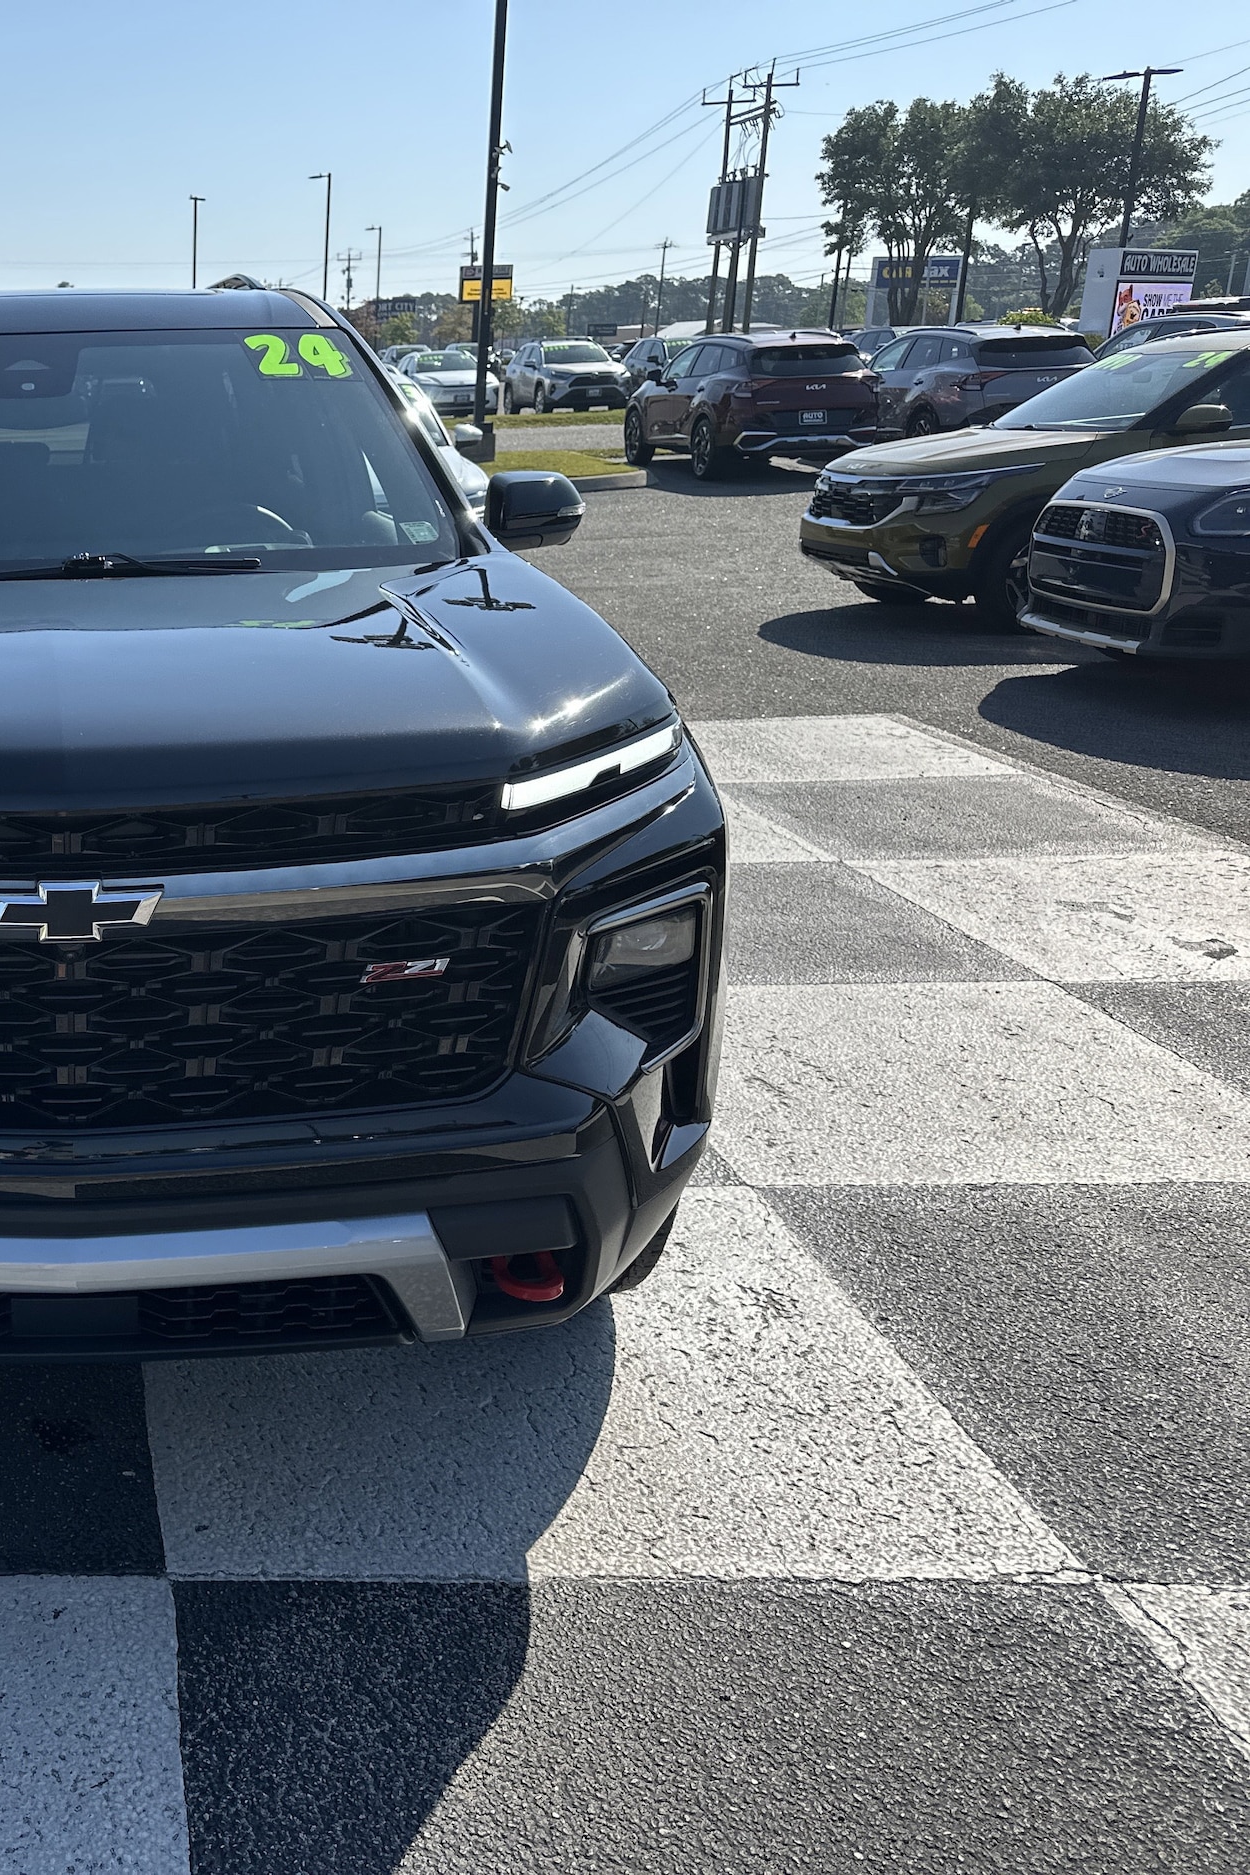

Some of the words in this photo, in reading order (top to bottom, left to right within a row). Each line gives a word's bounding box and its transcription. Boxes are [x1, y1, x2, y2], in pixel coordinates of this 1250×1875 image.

[1123, 254, 1149, 272] AUTO
[1150, 254, 1196, 273] WHOLESALE
[1143, 293, 1163, 307] SHOW
[244, 333, 354, 379] 24
[1182, 351, 1233, 369] 24
[803, 412, 823, 420] AUTO
[359, 957, 451, 984] Z71
